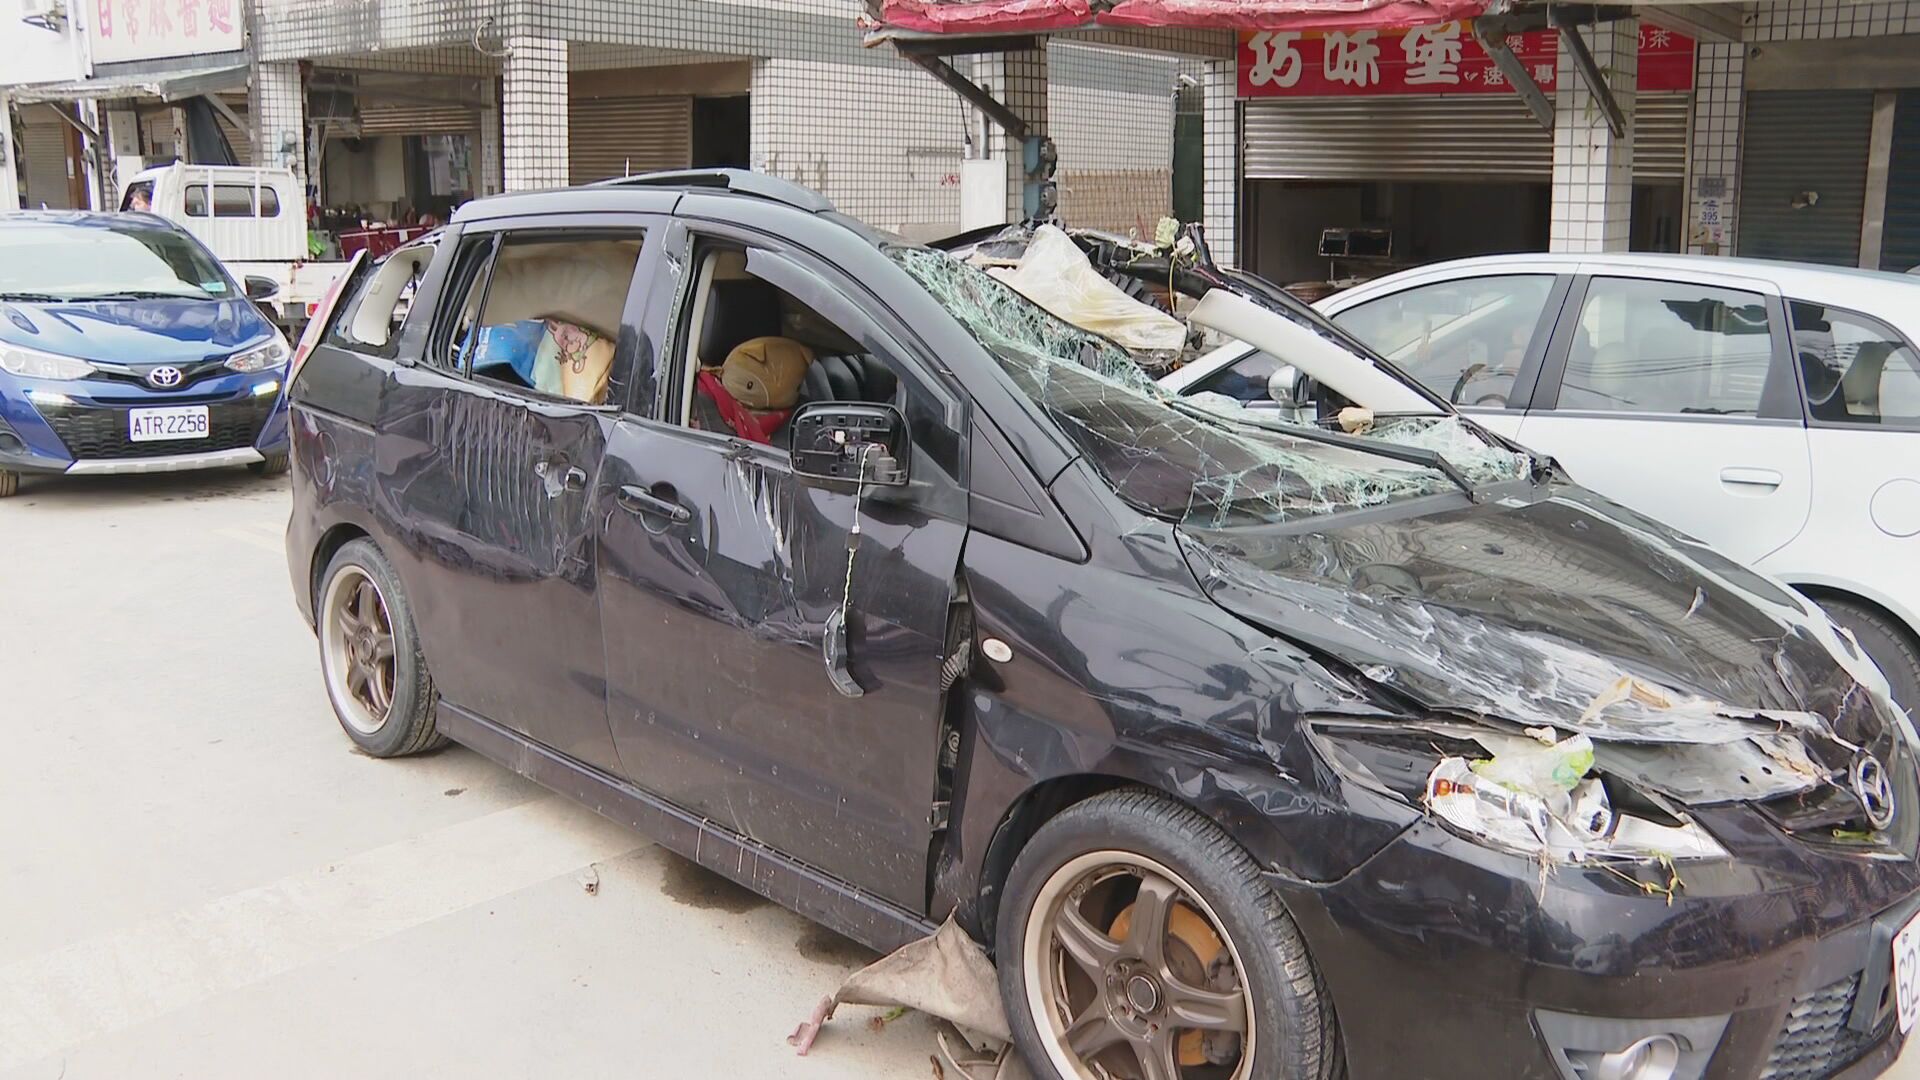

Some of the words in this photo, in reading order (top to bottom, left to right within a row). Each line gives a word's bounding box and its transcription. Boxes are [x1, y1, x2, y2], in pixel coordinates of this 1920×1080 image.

[1248, 20, 1462, 87] 巧味堡
[1483, 64, 1554, 86] 速專
[1702, 211, 1718, 221] 395
